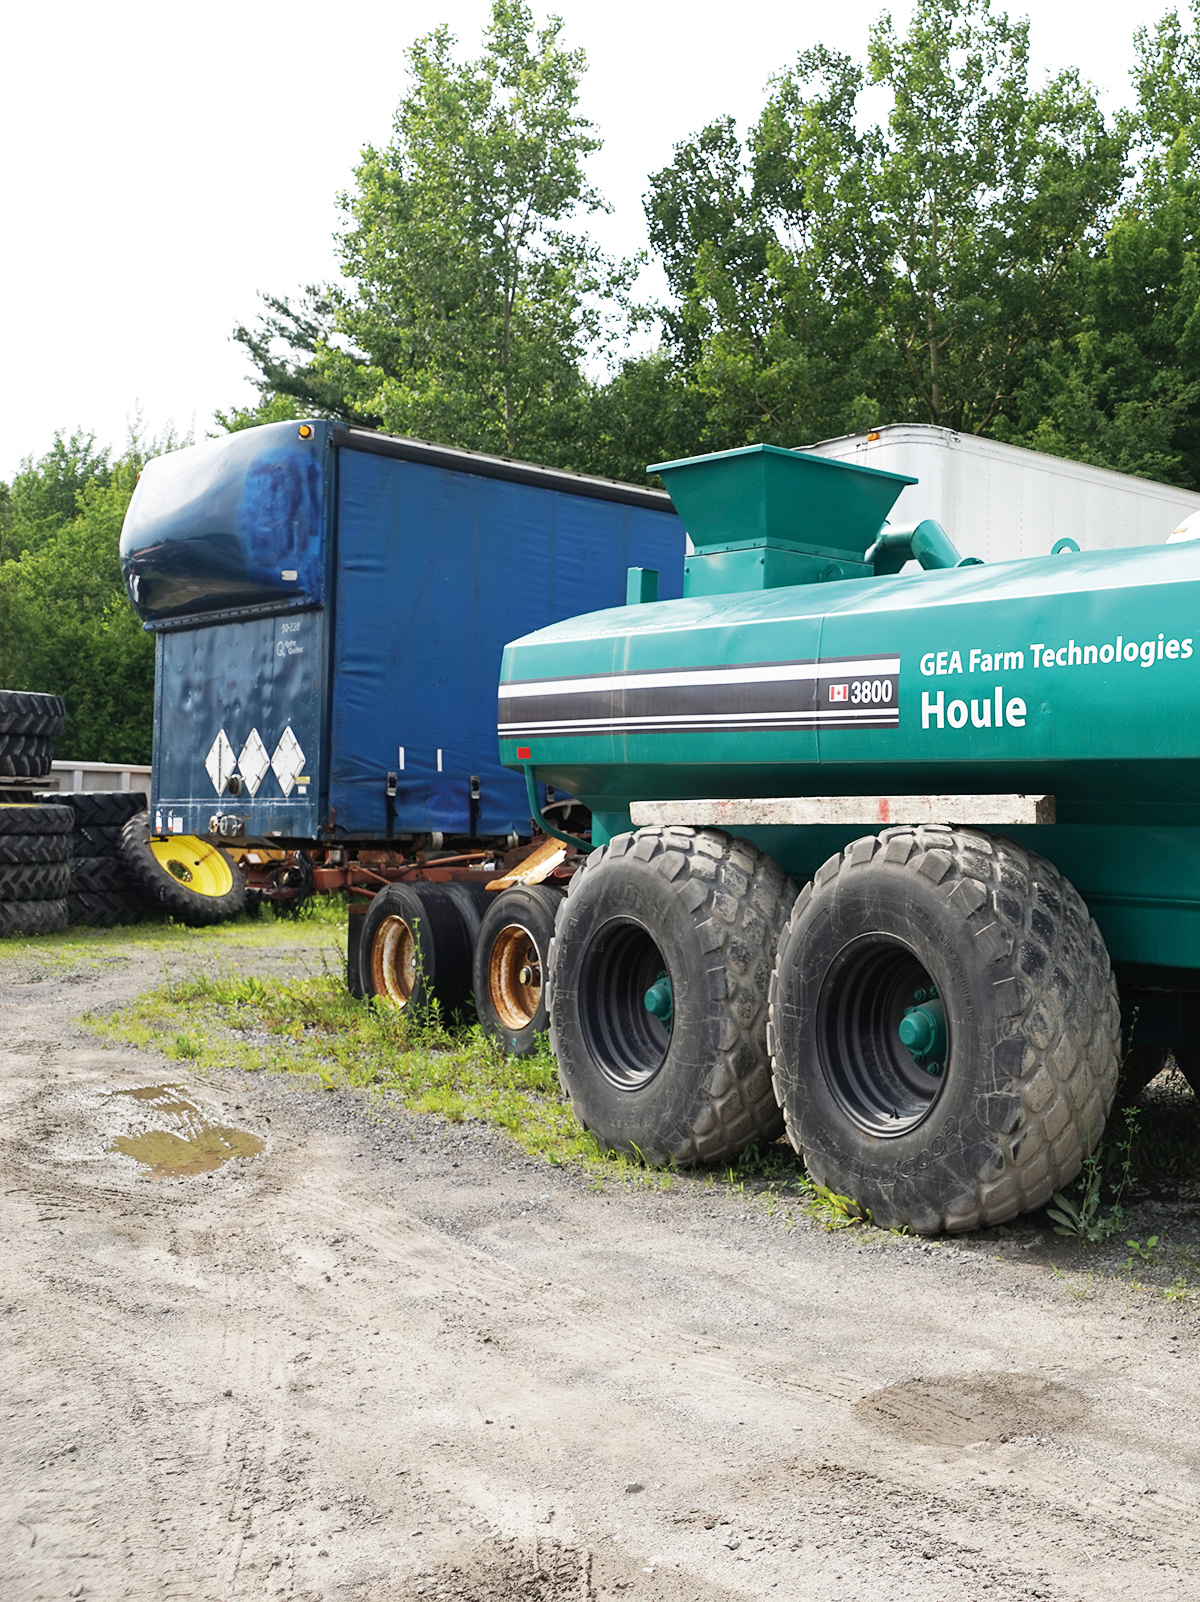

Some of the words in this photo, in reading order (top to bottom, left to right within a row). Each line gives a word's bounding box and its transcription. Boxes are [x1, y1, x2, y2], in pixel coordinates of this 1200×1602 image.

[919, 652, 963, 676] GEA
[968, 648, 1024, 673] Farm
[1030, 633, 1194, 668] Technologies
[851, 679, 893, 704] 3800
[921, 686, 1027, 730] Houle
